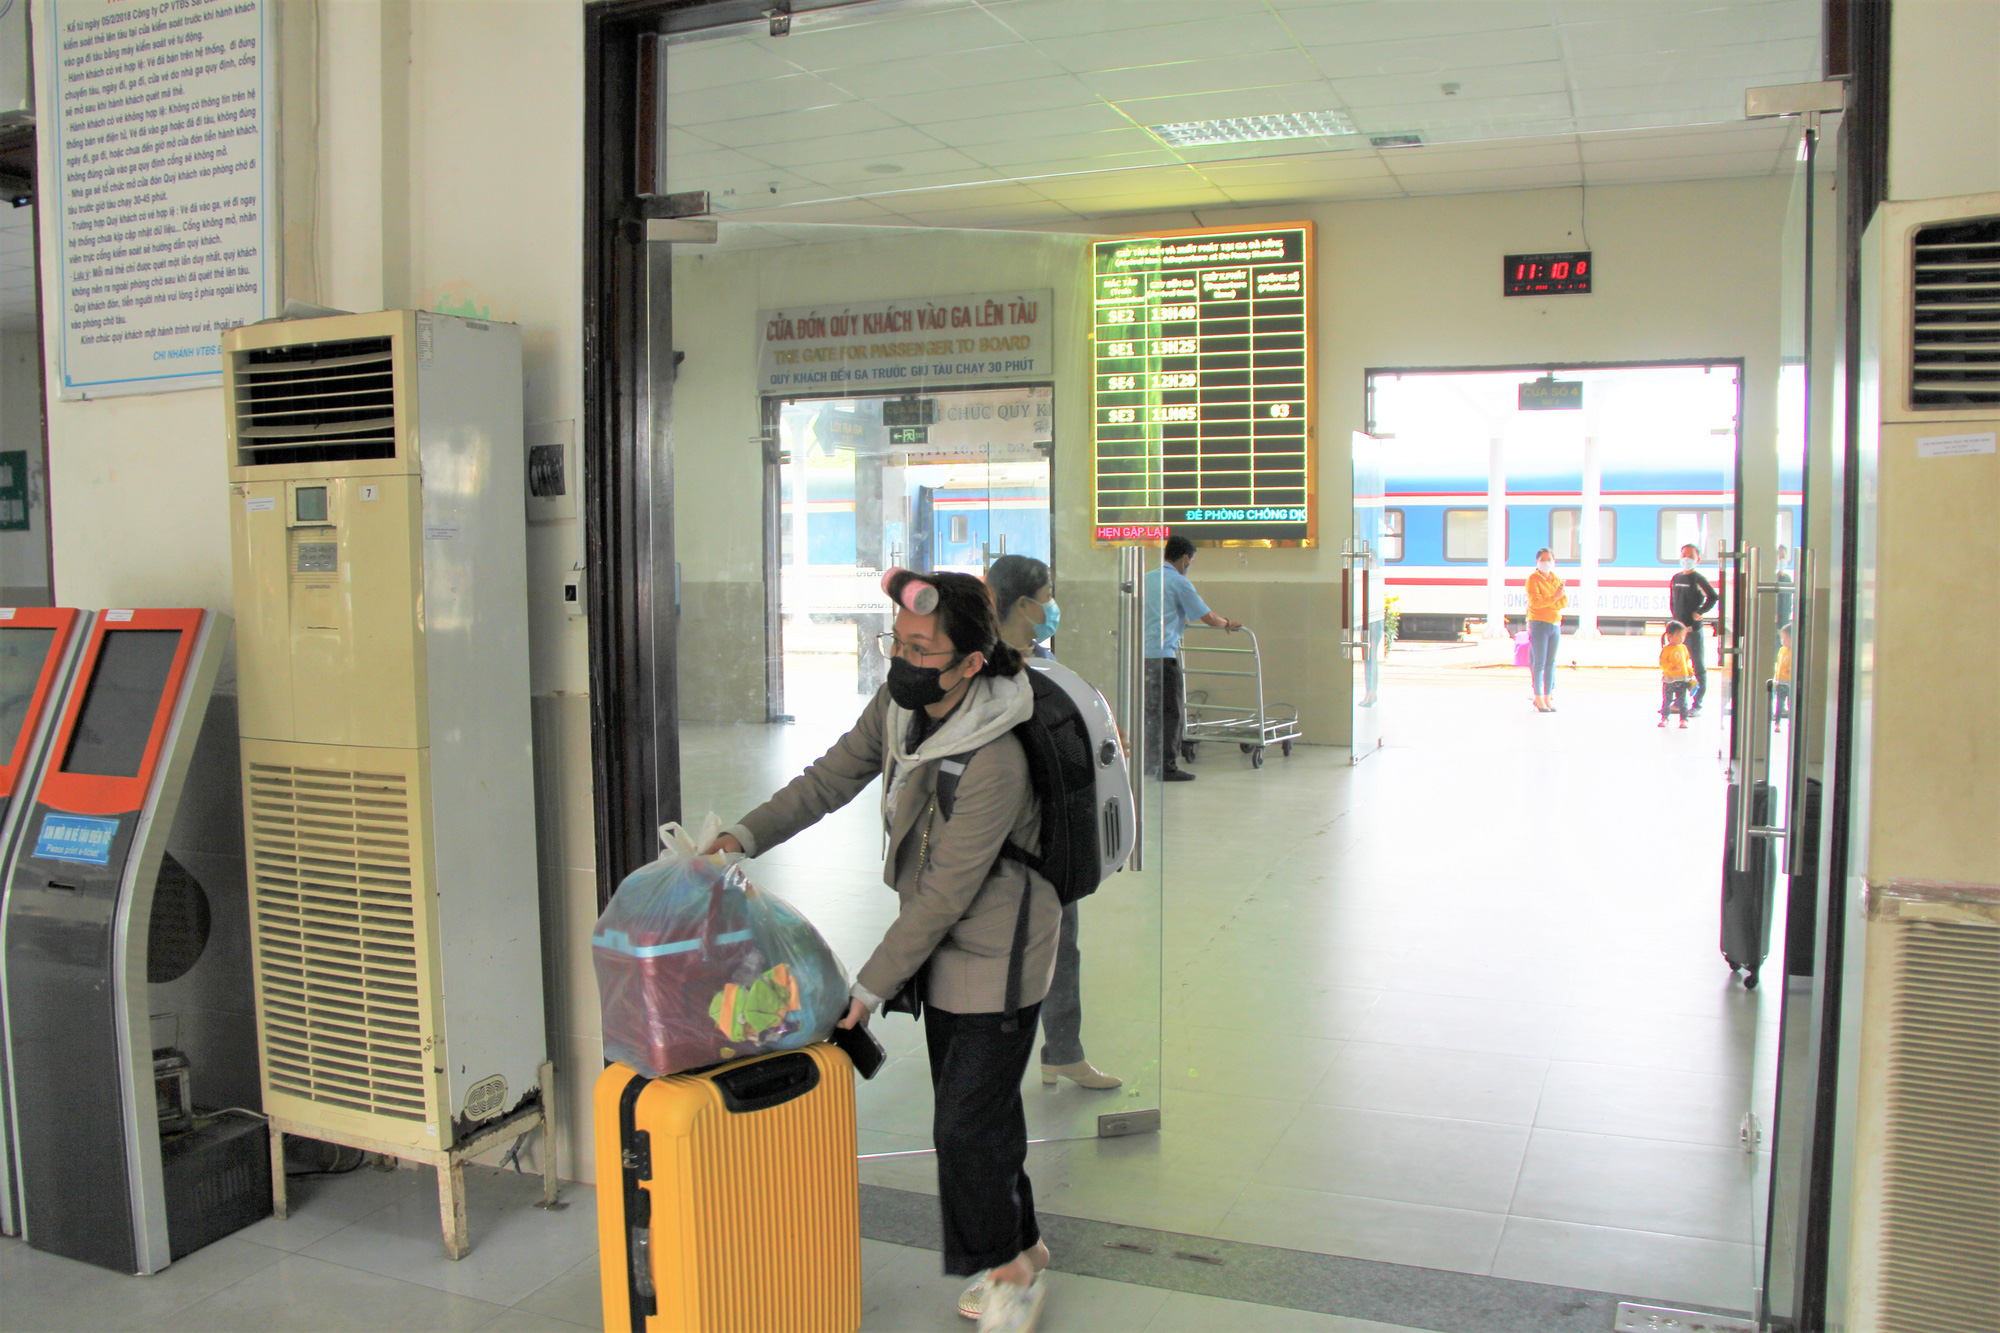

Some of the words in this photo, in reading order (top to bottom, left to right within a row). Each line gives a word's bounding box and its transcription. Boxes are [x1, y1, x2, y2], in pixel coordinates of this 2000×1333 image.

[101, 11, 131, 27] 05/2/2018
[159, 3, 169, 15] CP
[133, 193, 151, 204] 30-45
[766, 311, 794, 341] CỬA
[797, 310, 826, 339] ĐÓN
[863, 304, 912, 334] KHÁCH
[917, 302, 947, 331] VÀO
[951, 305, 972, 330] GA
[975, 299, 1002, 327] LÊN
[1009, 296, 1038, 324] TÀU
[1108, 310, 1135, 323] SE2
[1151, 306, 1197, 321] 13H40
[152, 350, 166, 360] CHI
[774, 348, 801, 365] THE
[802, 346, 838, 363] GATE
[840, 344, 867, 361] FOR
[870, 339, 954, 360] PASSENGER
[956, 338, 974, 353] TO
[979, 335, 1031, 353] BOARD
[1108, 343, 1135, 357] SE1
[1151, 339, 1197, 354] 13H25
[793, 366, 828, 384] KHÁCH
[830, 364, 851, 381] ĐẾN
[854, 368, 869, 380] GA
[872, 363, 907, 379] TRƯỚC
[933, 360, 953, 375] TÀU
[956, 361, 985, 376] CHẠY
[988, 360, 1001, 373] 30
[1004, 356, 1034, 372] PHÚT
[1108, 377, 1135, 390] SE4
[1151, 374, 1197, 388] 12H20
[947, 402, 991, 421] CHÚC
[1108, 409, 1135, 423] SE3
[1152, 407, 1197, 422] 11H05
[1270, 404, 1290, 418] 03
[365, 489, 371, 498] 7
[1204, 508, 1244, 520] PHÒNG
[1246, 507, 1287, 520] CHỐNG
[1097, 526, 1120, 540] HẸN
[1122, 525, 1145, 540] GẶP
[1147, 526, 1163, 540] LẠ
